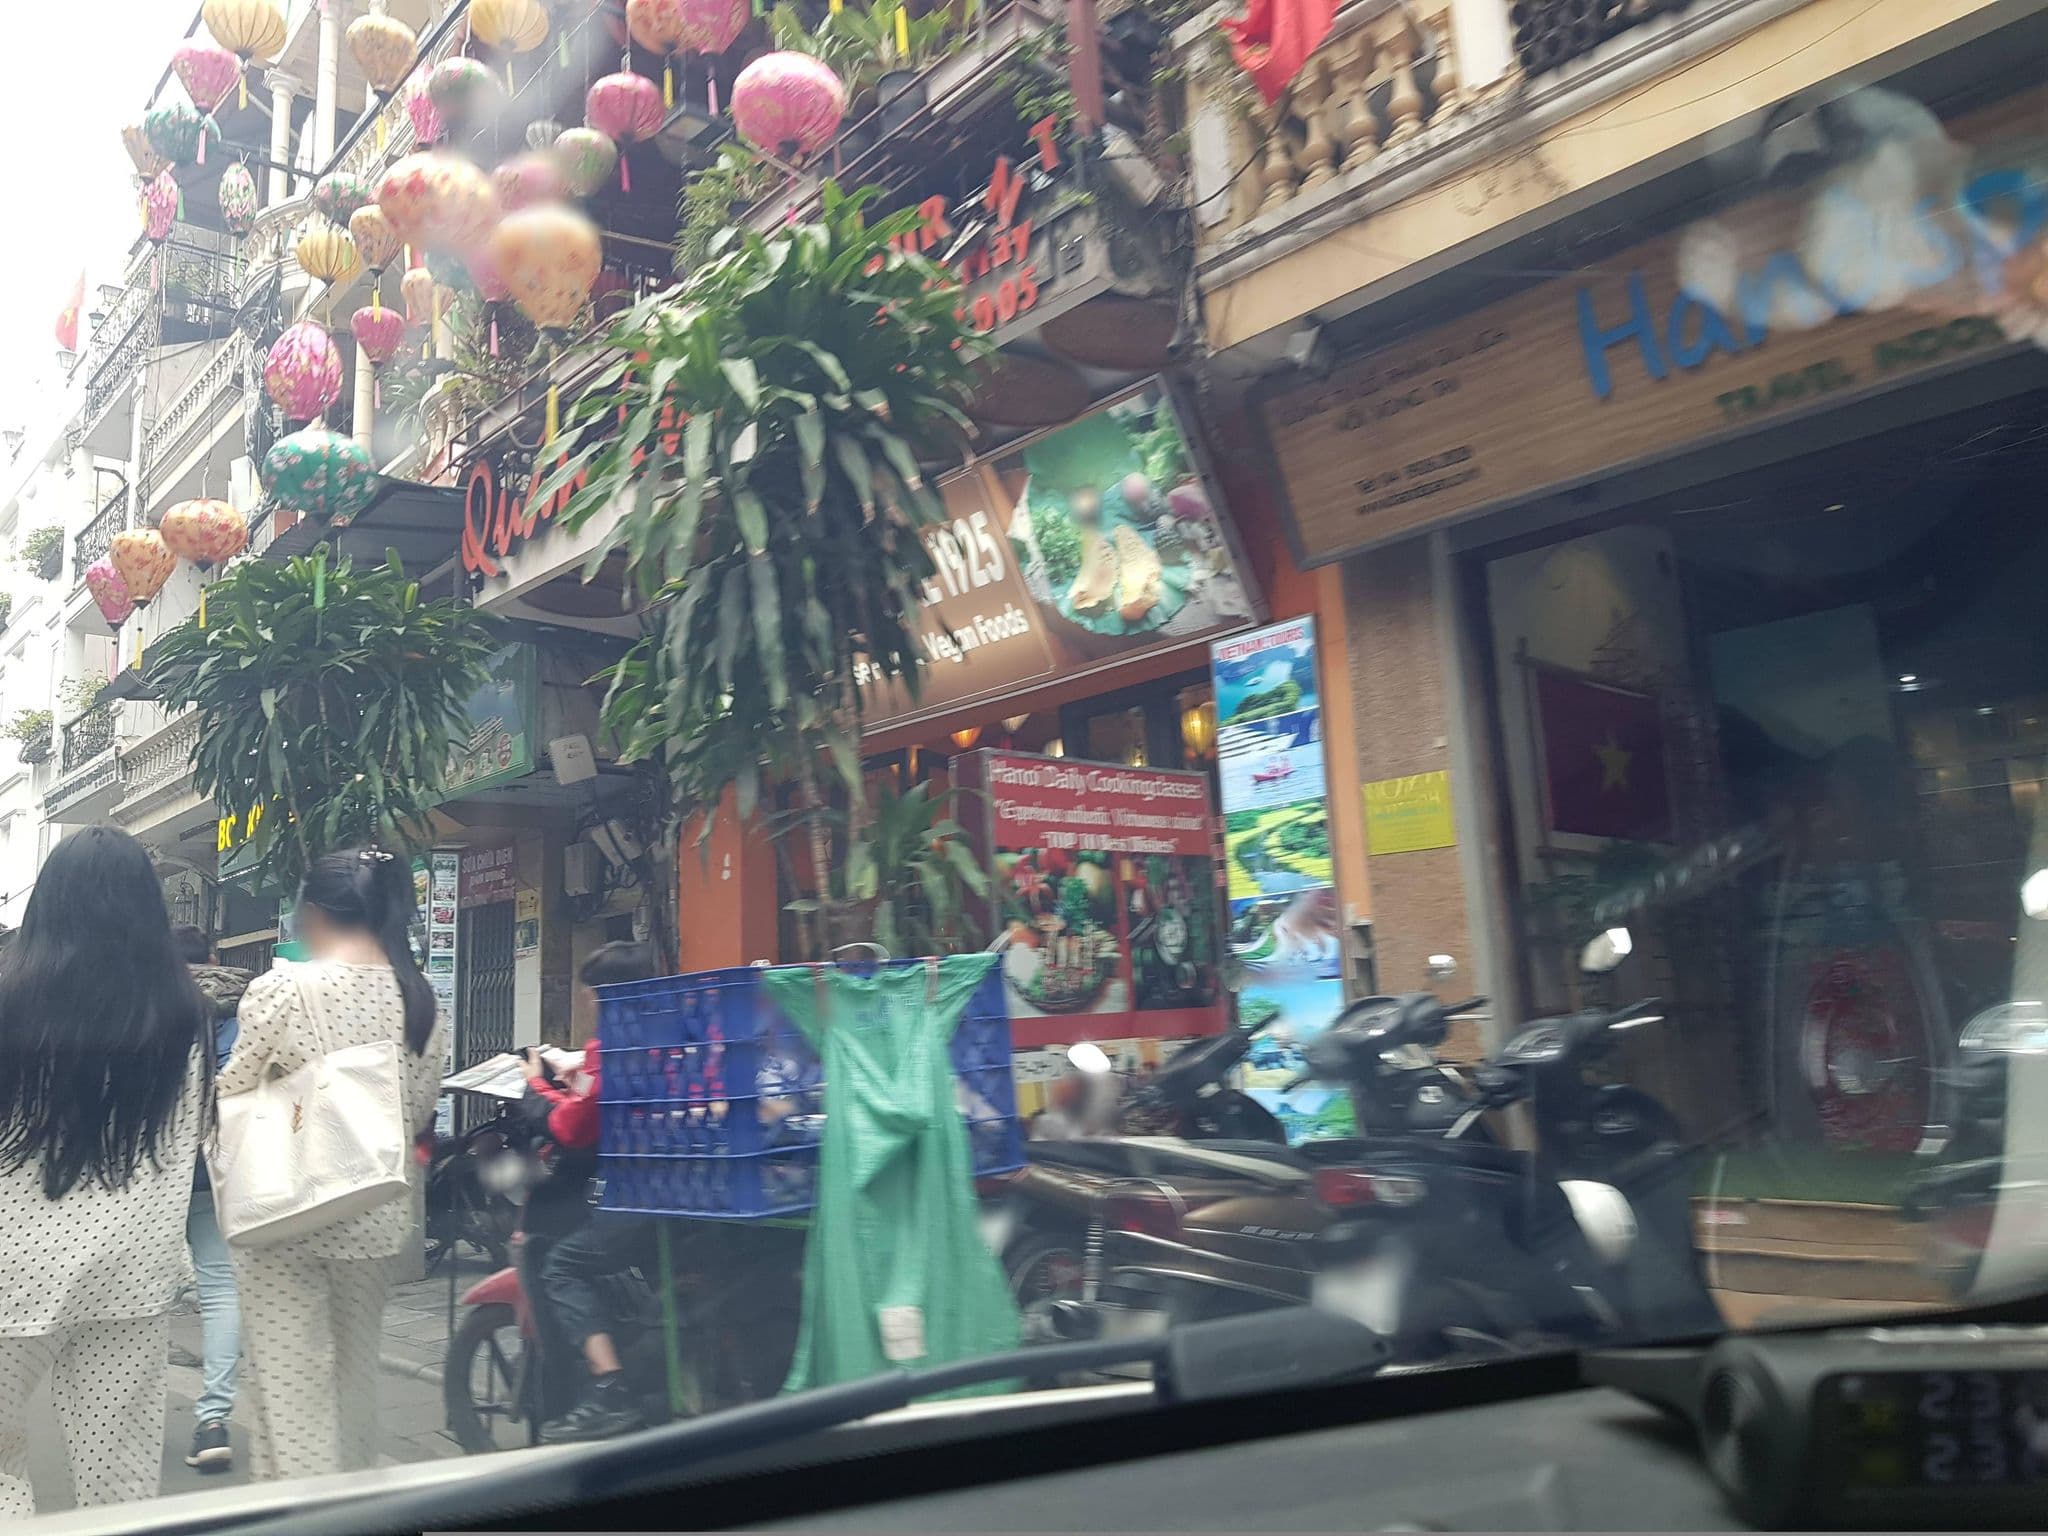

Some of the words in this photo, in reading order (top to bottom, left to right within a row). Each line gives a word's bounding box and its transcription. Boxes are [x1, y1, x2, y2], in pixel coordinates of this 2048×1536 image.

[928, 511, 1006, 597] 1925
[921, 625, 981, 663] Vegan
[973, 603, 1031, 645] Foods
